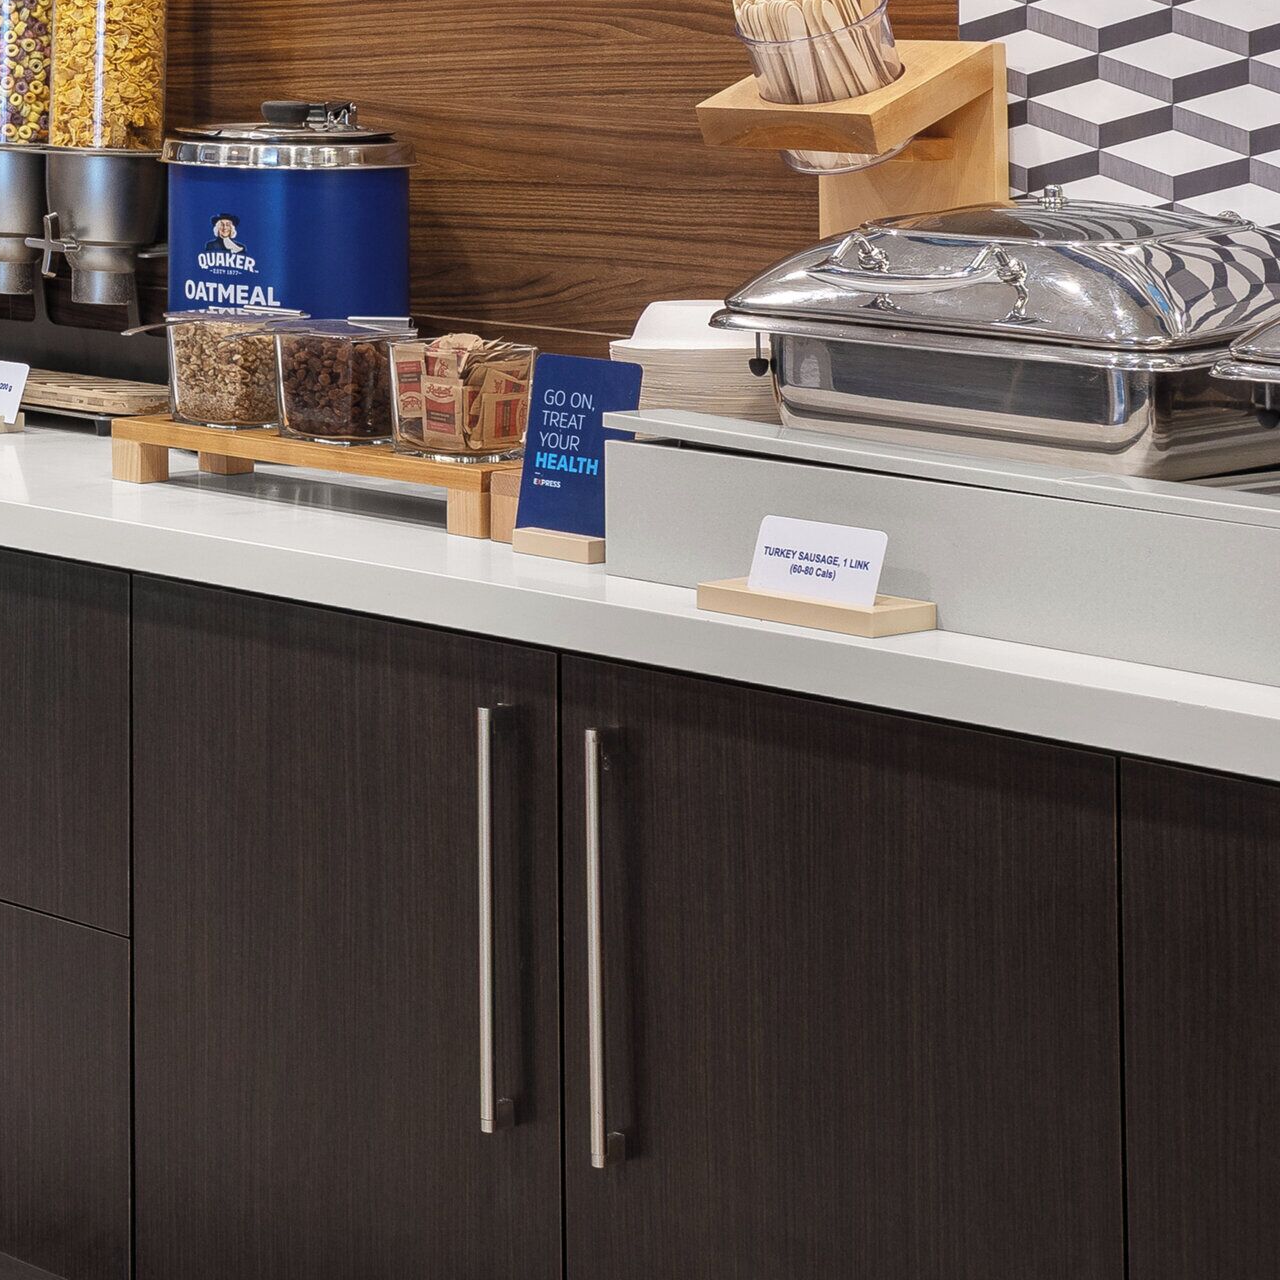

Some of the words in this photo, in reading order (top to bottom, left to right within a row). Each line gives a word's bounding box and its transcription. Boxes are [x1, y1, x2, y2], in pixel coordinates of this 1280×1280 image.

[197, 252, 256, 273] QUAKER
[184, 279, 281, 307] OATMEAL
[543, 388, 566, 407] GO
[570, 391, 595, 412] ON,
[542, 409, 586, 431] TREAT
[539, 431, 580, 452] YOUR
[535, 451, 599, 476] HEALTH
[532, 477, 561, 489] EXPRESS
[763, 545, 798, 560] TURKEY
[797, 551, 840, 567] SAUSAGE,
[849, 558, 870, 571] LINK
[815, 567, 837, 581] Cals)
